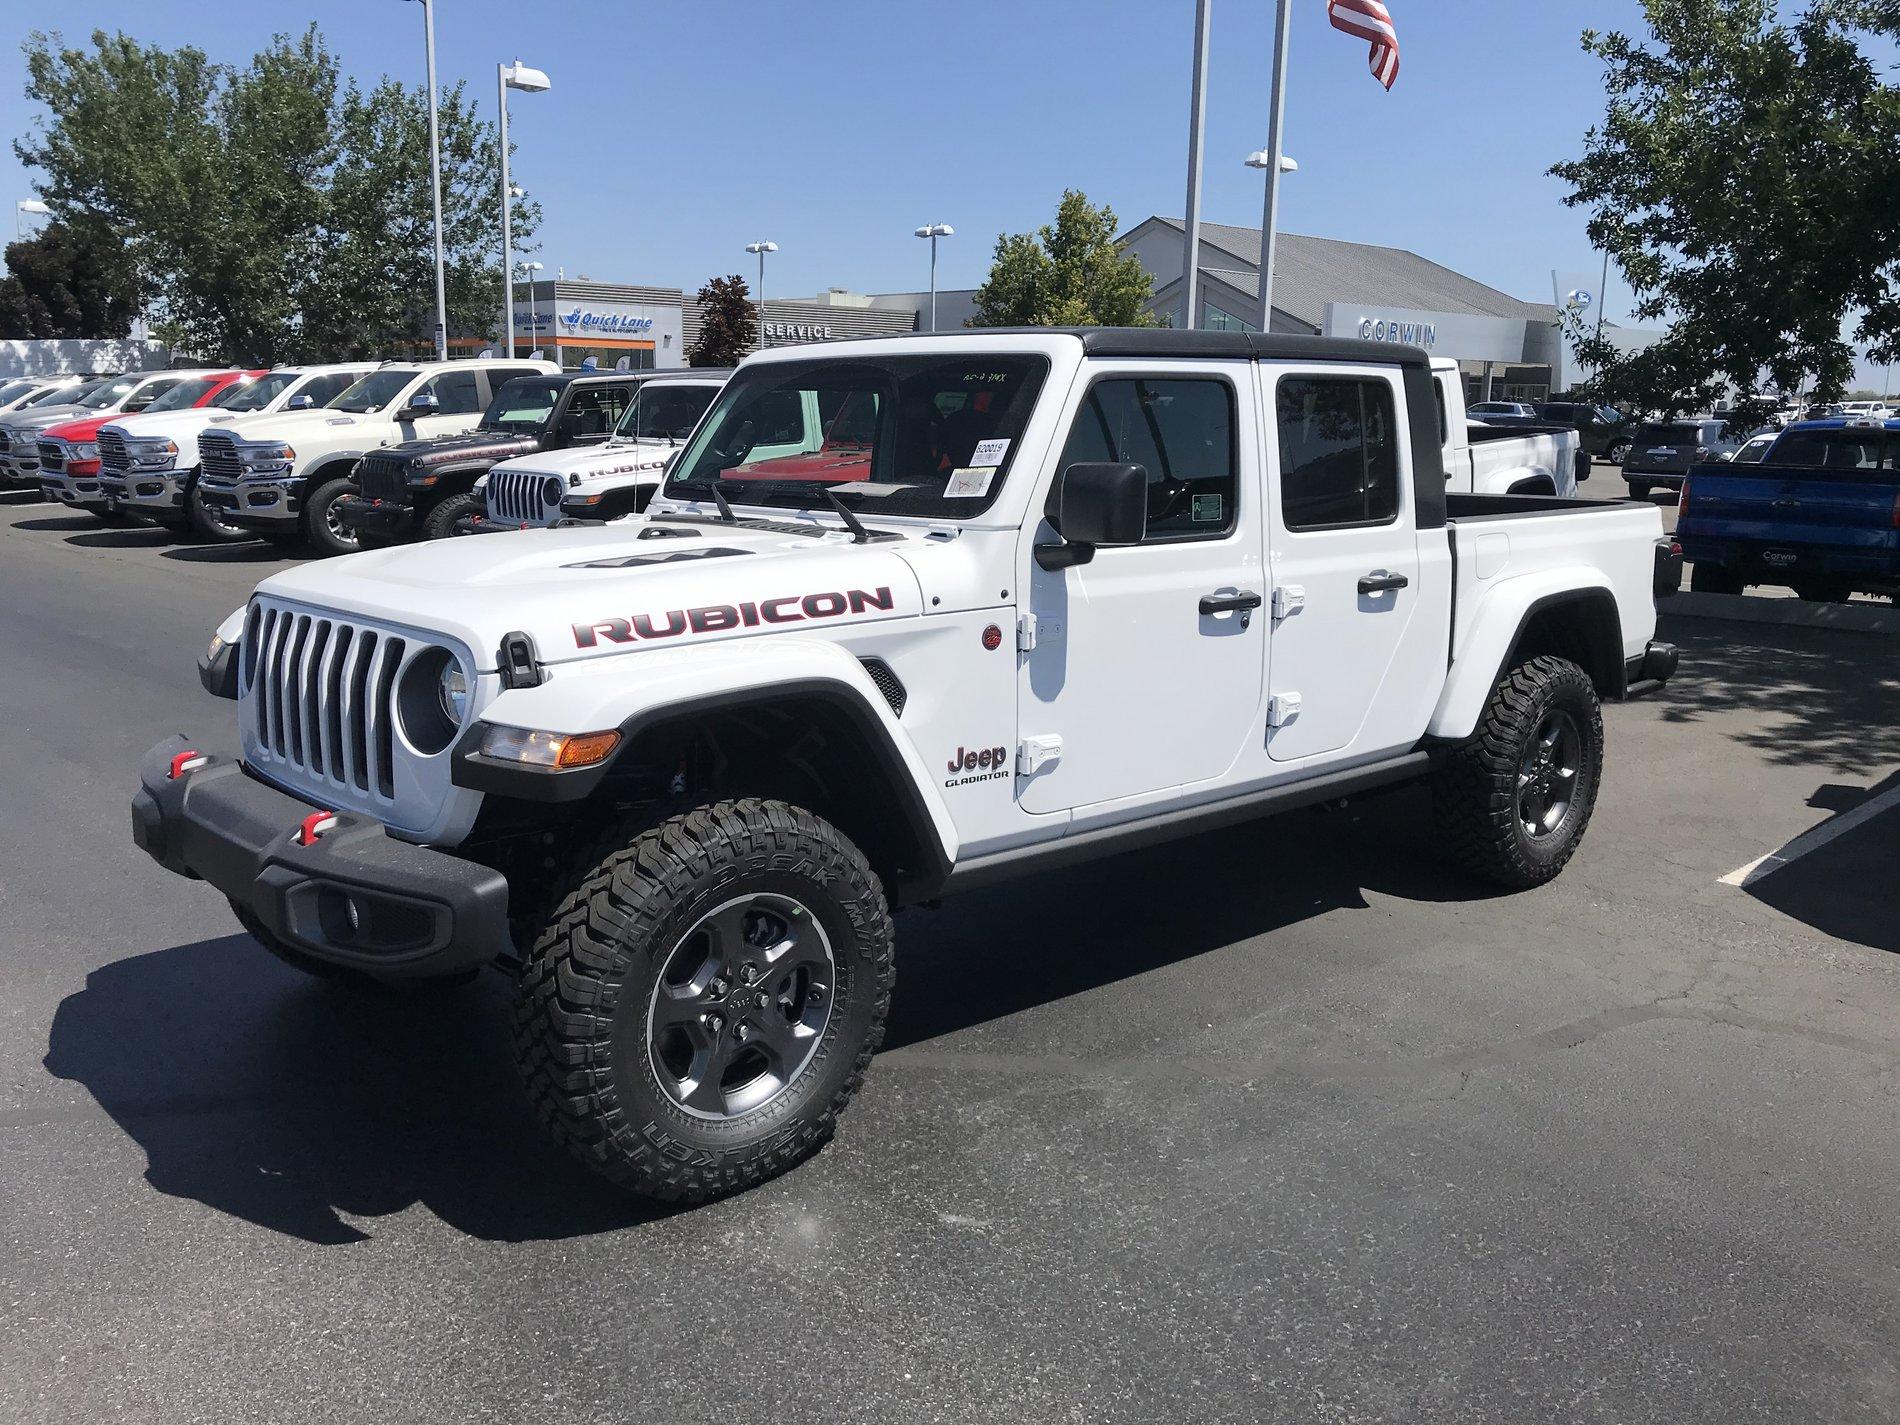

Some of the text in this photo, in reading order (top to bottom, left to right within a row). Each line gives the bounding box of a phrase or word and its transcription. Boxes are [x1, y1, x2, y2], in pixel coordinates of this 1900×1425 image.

[581, 312, 653, 328] Quick Lane
[765, 323, 832, 338] SERVICE
[1361, 319, 1436, 344] CORWIN
[589, 461, 666, 477] RUBICO
[1763, 551, 1797, 561] Corwin
[571, 586, 894, 648] RUBICON
[948, 746, 1006, 773] Jeep
[945, 771, 1009, 787] GLADIATOR
